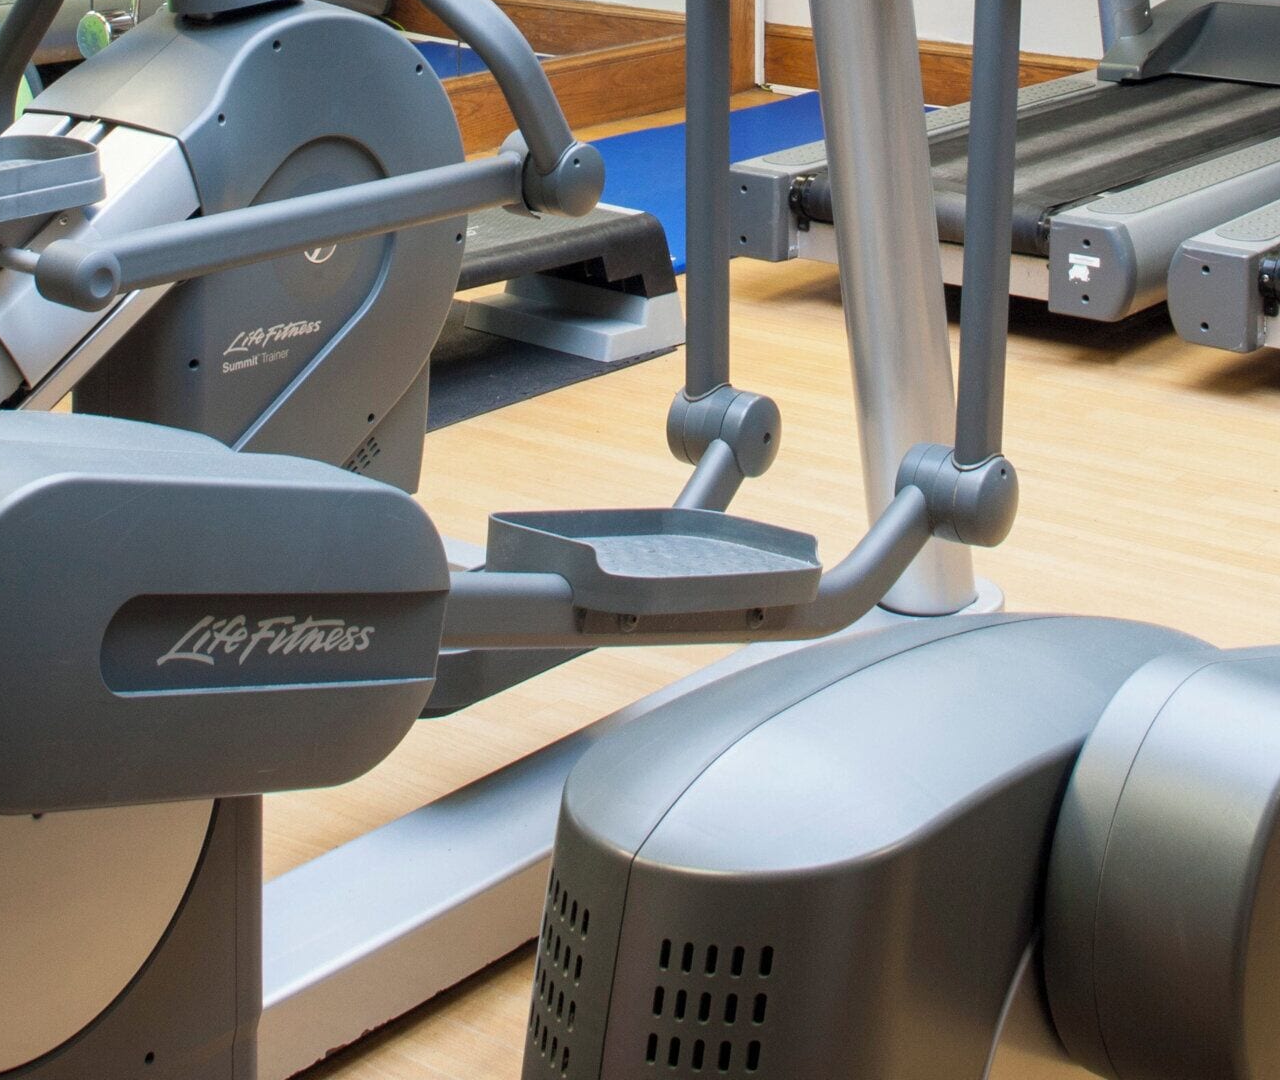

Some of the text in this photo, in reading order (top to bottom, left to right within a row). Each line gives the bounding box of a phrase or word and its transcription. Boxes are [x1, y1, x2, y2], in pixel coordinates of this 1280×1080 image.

[223, 320, 322, 356] Life Fitness
[222, 349, 290, 374] Summit Trainer
[156, 615, 375, 666] Life Fitness
